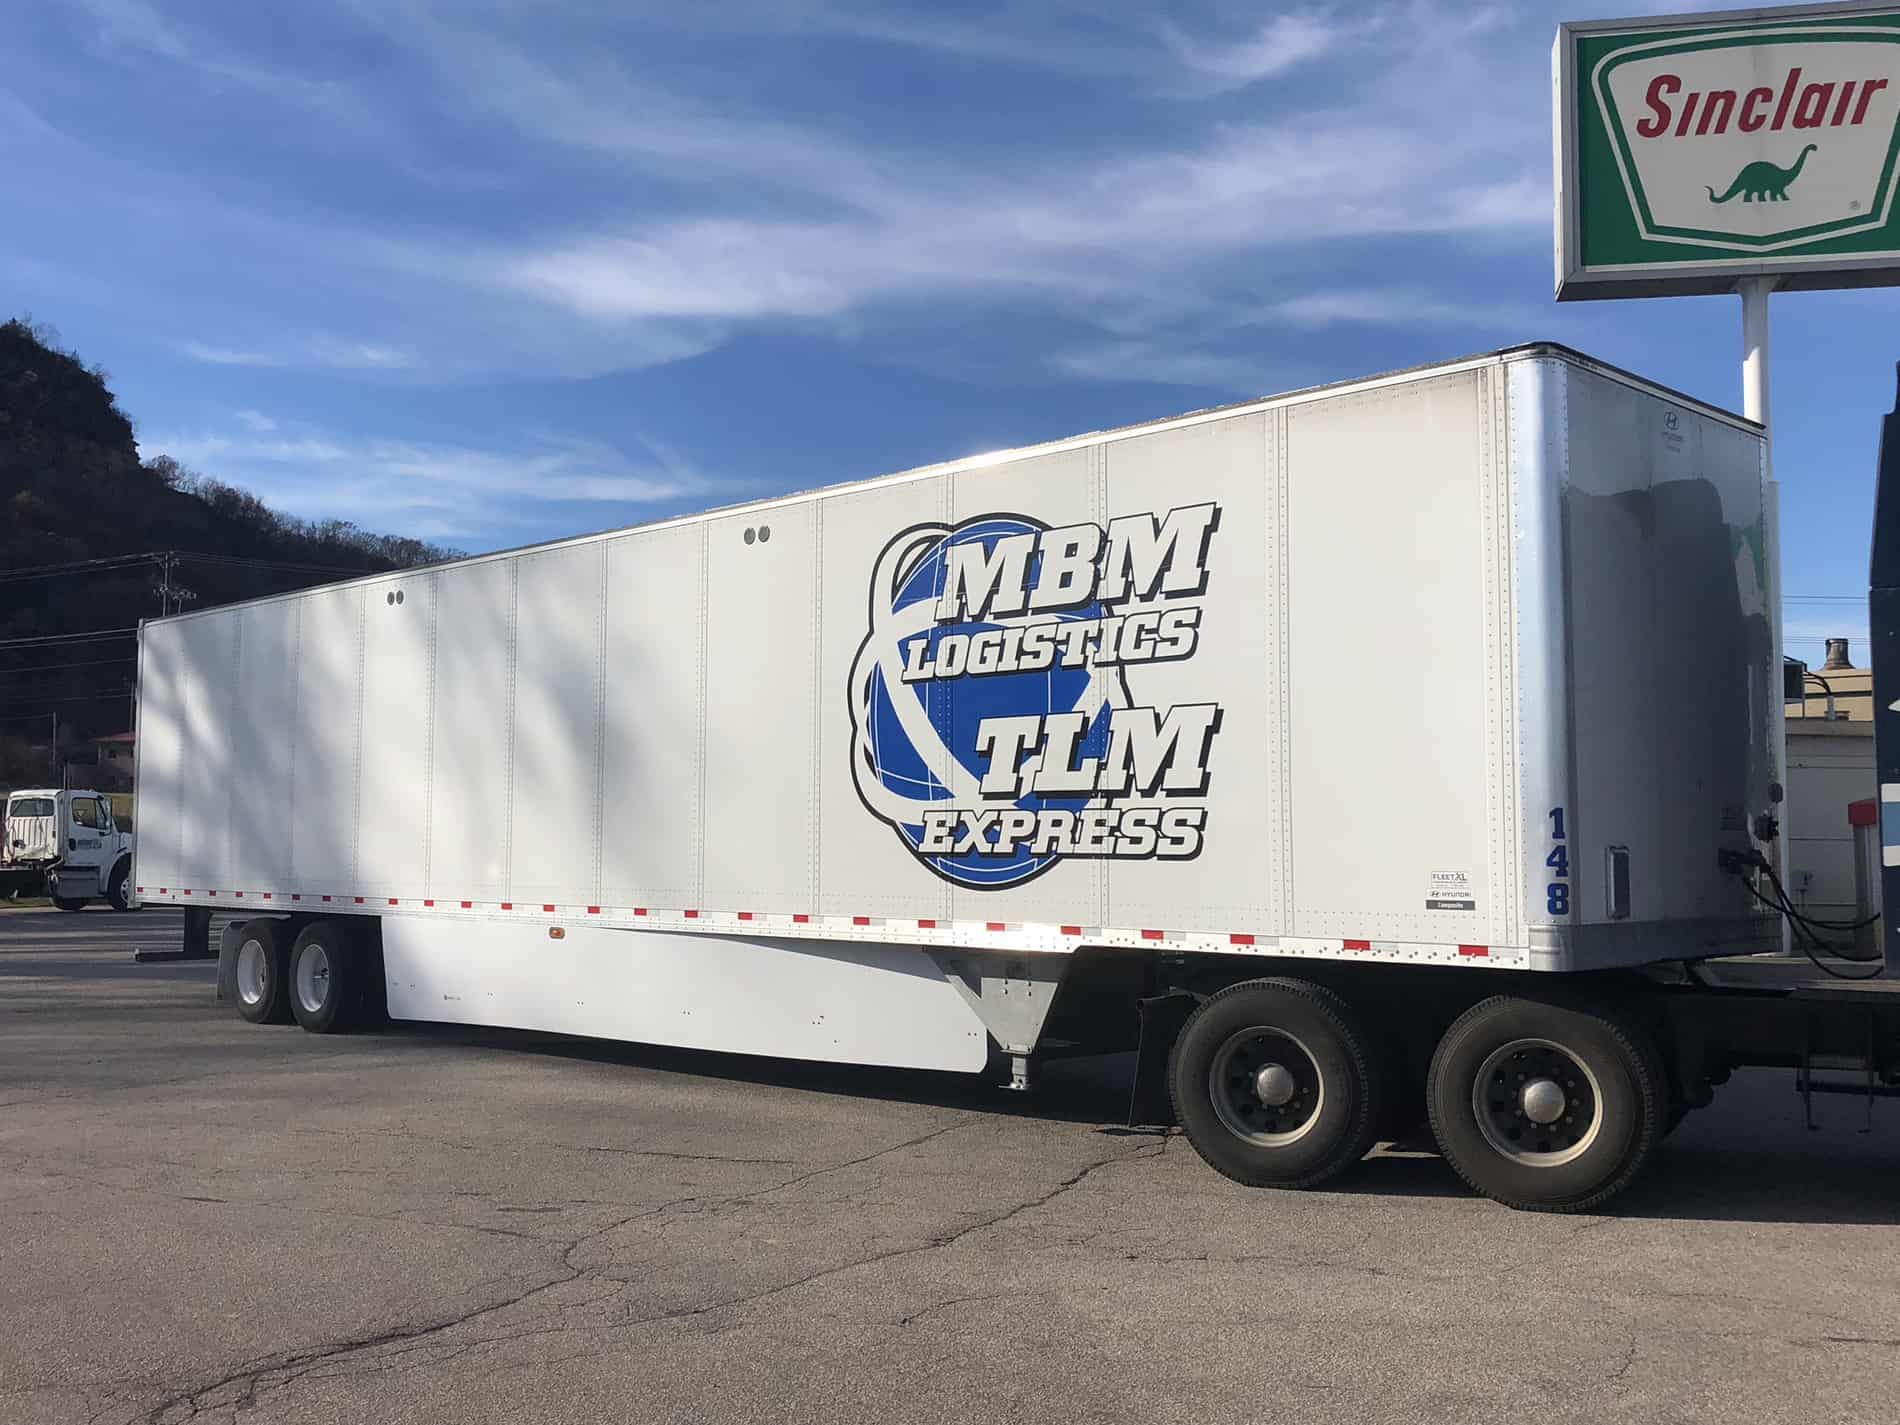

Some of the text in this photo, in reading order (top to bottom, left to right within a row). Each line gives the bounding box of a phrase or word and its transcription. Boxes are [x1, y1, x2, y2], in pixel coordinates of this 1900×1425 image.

[1636, 67, 1889, 138] Sinclair
[934, 502, 1222, 622] MBM
[901, 606, 1204, 684] LOGISTICS
[975, 702, 1223, 799] TLM
[917, 807, 1208, 861] EXPRESS
